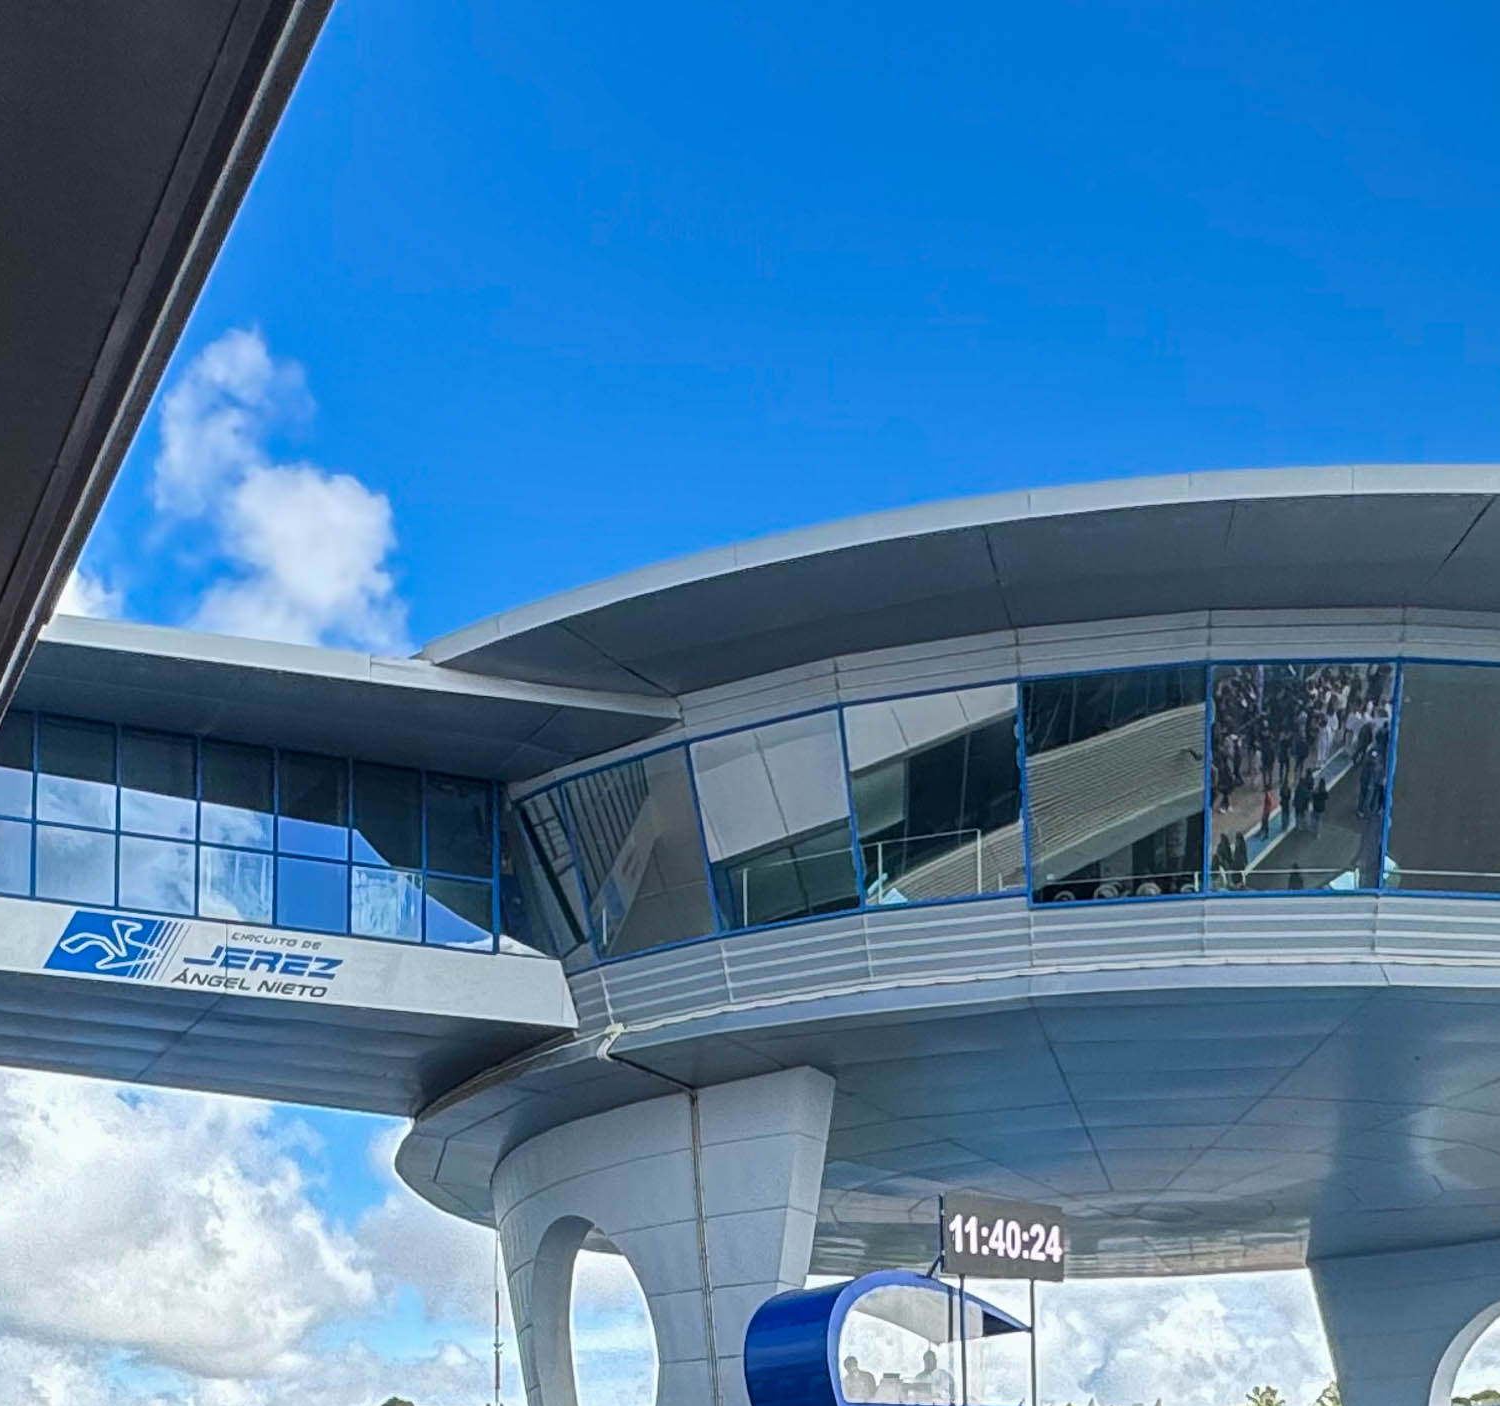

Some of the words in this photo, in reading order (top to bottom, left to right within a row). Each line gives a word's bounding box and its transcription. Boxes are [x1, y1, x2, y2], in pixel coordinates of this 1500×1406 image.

[231, 932, 298, 947] CIRCUITO
[301, 940, 322, 951] DE
[183, 945, 343, 980] JEREZ
[171, 968, 251, 991] ÁNGEL
[257, 979, 328, 998] NIETO
[948, 1214, 1063, 1263] 11:40:24
